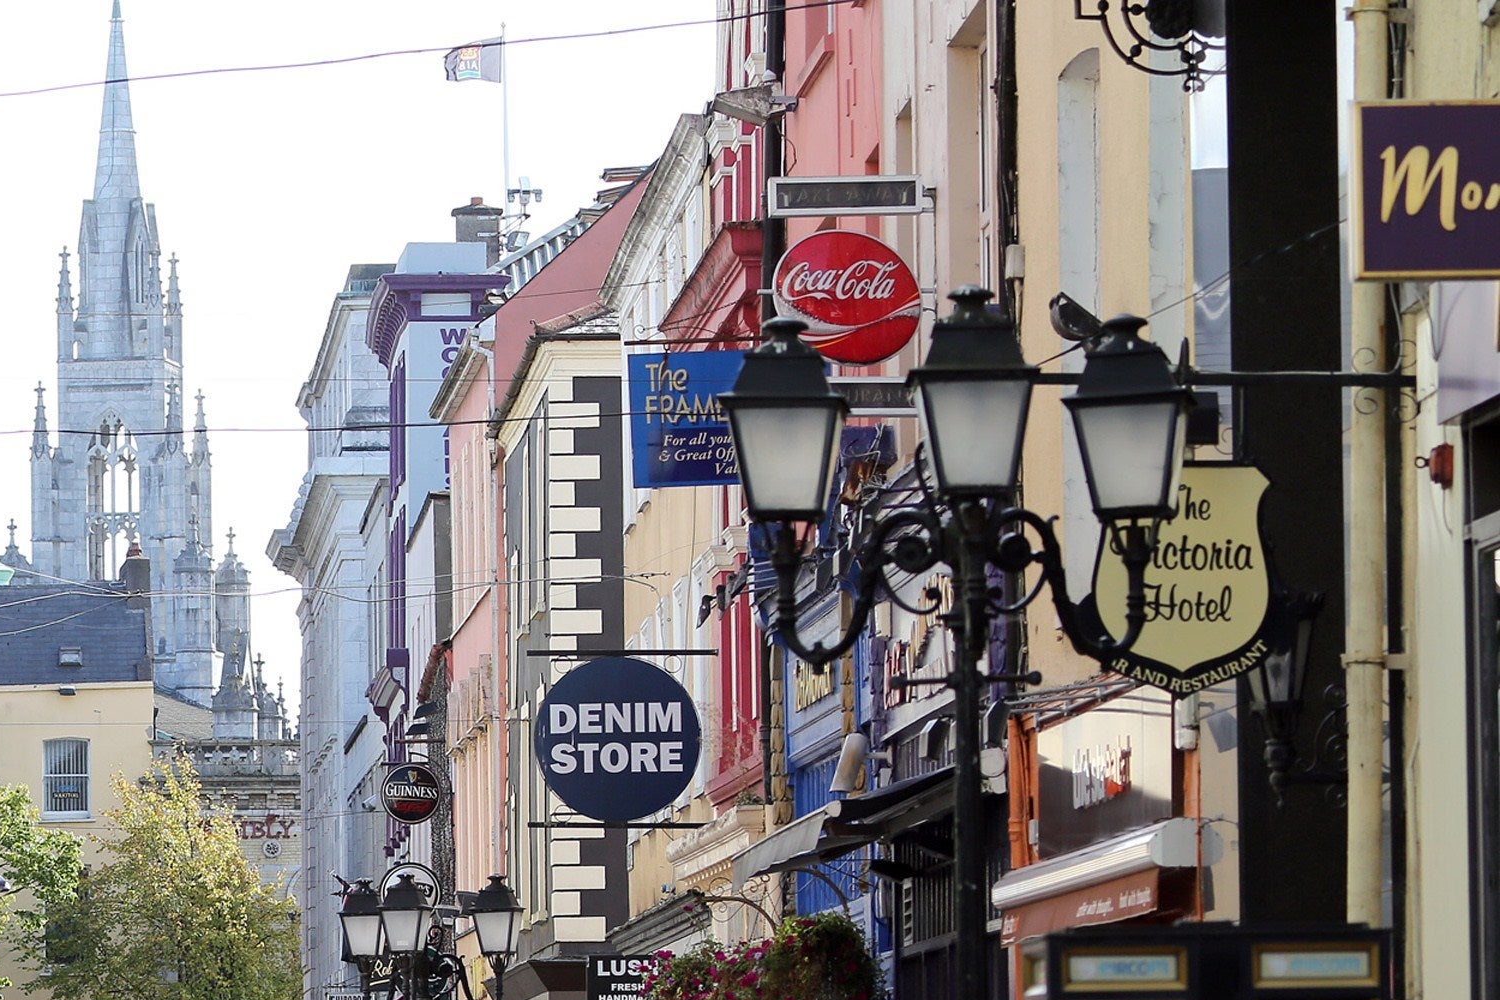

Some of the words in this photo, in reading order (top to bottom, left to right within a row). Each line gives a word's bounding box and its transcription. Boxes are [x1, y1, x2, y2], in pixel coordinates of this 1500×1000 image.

[781, 259, 901, 300] Coca-Cola
[645, 361, 689, 392] The
[658, 450, 670, 462] &
[674, 449, 712, 462] Great
[663, 434, 686, 447] For
[689, 432, 707, 445] all
[709, 435, 733, 448] you
[1143, 584, 1232, 622] Hotel
[1131, 665, 1169, 687] AND
[1169, 638, 1269, 694] RESTAURANT
[548, 701, 683, 734] DENIM
[549, 741, 684, 775] STORE
[385, 782, 438, 800] GUINNESS
[611, 983, 646, 992] FRESH
